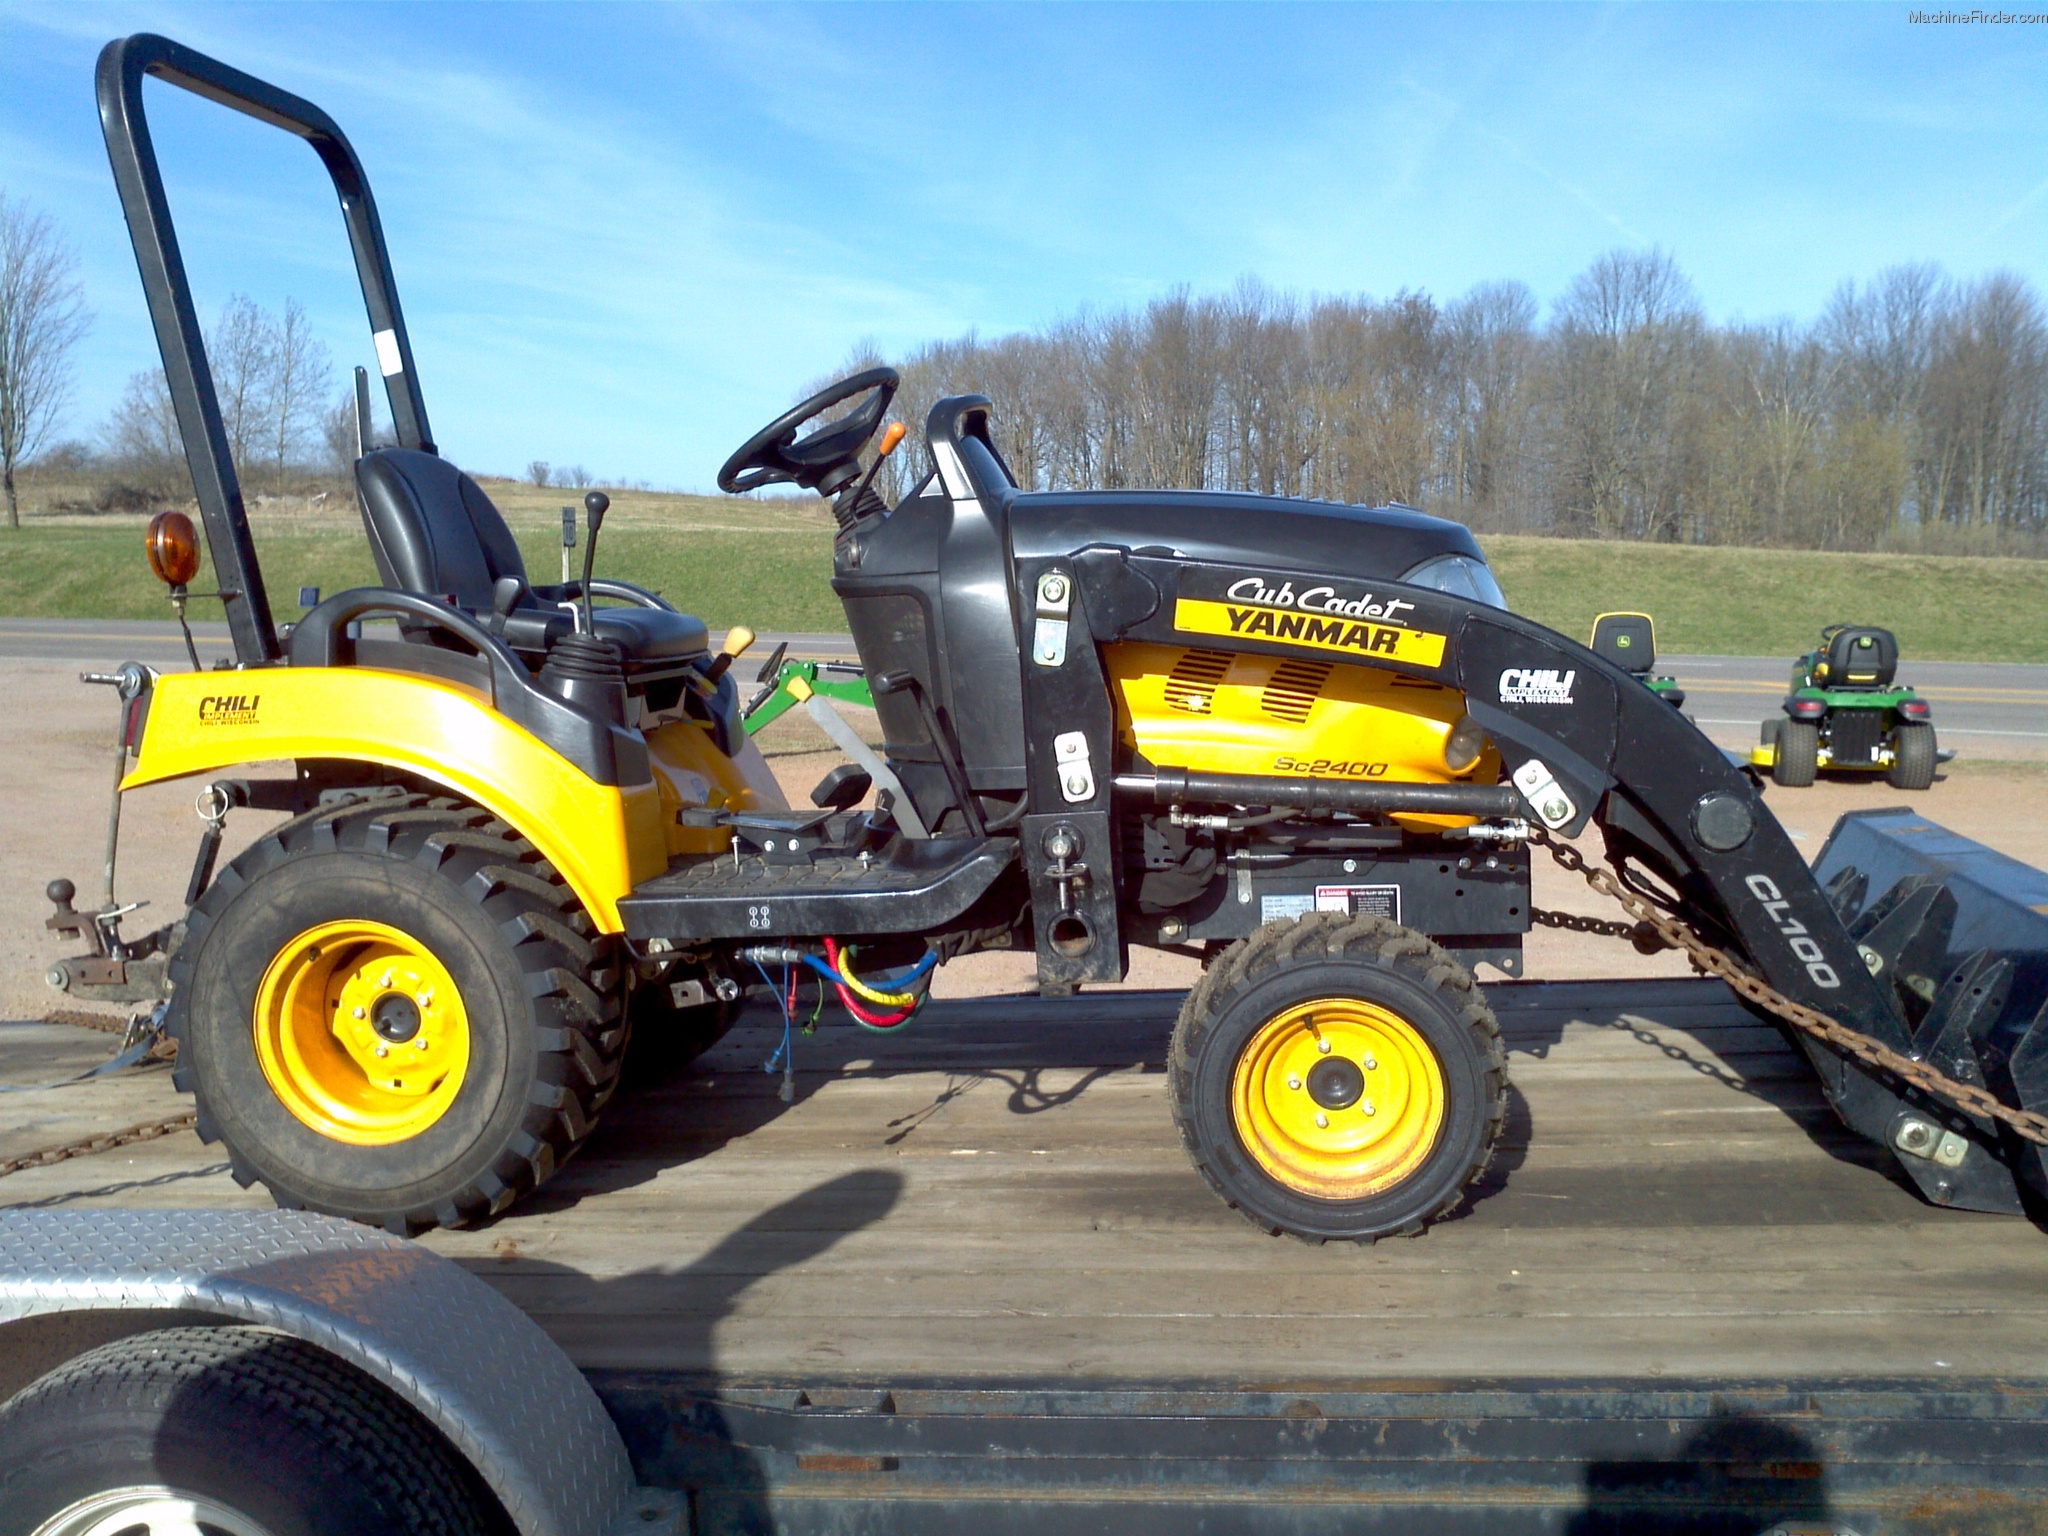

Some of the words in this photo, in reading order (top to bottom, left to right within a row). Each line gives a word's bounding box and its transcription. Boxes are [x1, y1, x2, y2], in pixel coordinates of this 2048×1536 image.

[1226, 577, 1294, 607] Cub
[1296, 586, 1416, 622] Cadet
[1227, 607, 1401, 654] YANMAR
[1499, 668, 1576, 697] CHILI
[1506, 688, 1567, 696] IMPLEMENT
[199, 695, 260, 720] CHILI
[1745, 874, 1841, 988] CL100
